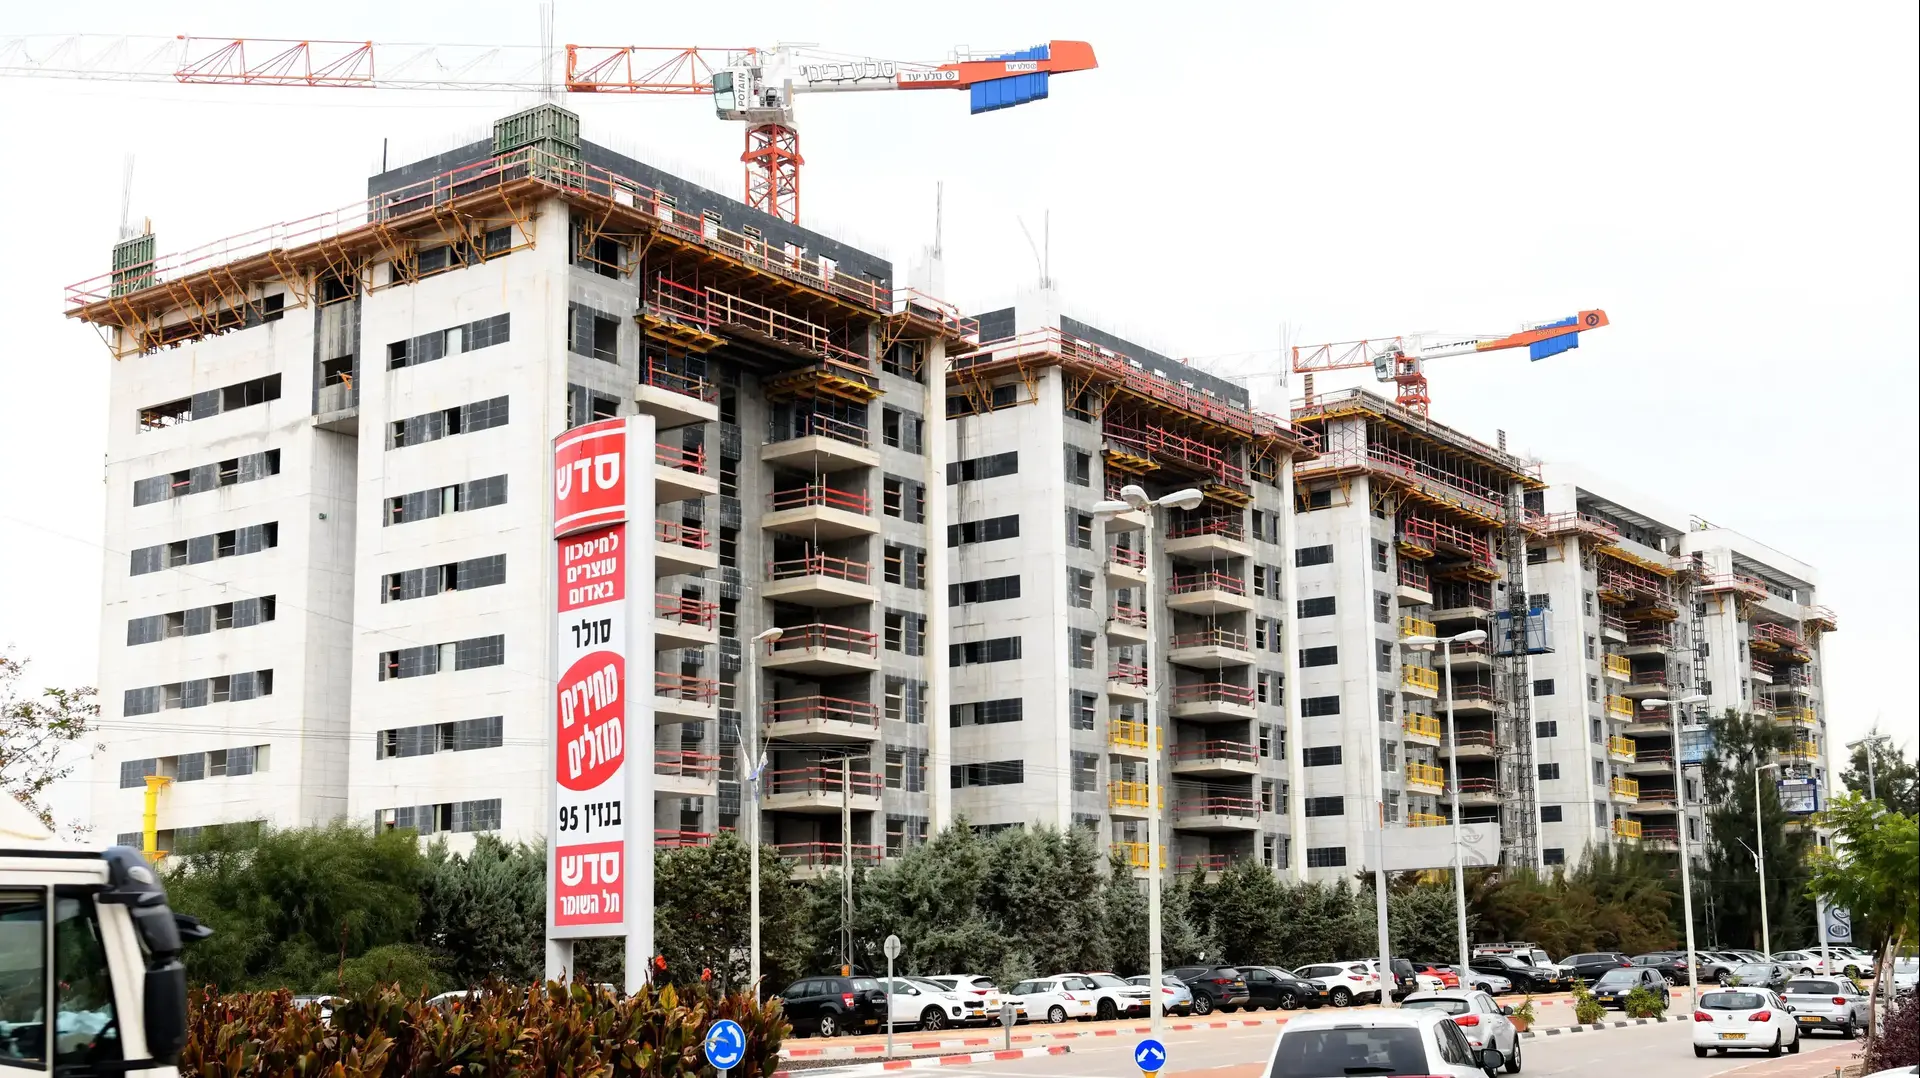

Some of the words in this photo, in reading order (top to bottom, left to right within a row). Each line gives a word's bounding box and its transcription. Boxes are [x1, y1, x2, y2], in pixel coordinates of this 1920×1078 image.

[851, 57, 897, 80] סלע
[738, 73, 746, 107] POTAIN
[556, 452, 620, 501] סדש
[565, 532, 619, 566] לחיסכון
[566, 557, 616, 584] עוצרים
[569, 580, 614, 605] באדום
[572, 618, 612, 648] סולר
[560, 663, 618, 729] מחירים
[567, 716, 622, 780] מוזלים
[559, 805, 578, 831] 95
[584, 800, 621, 833] בנזין
[560, 851, 620, 887] סדש
[560, 894, 599, 916] השומר
[602, 889, 620, 913] תל
